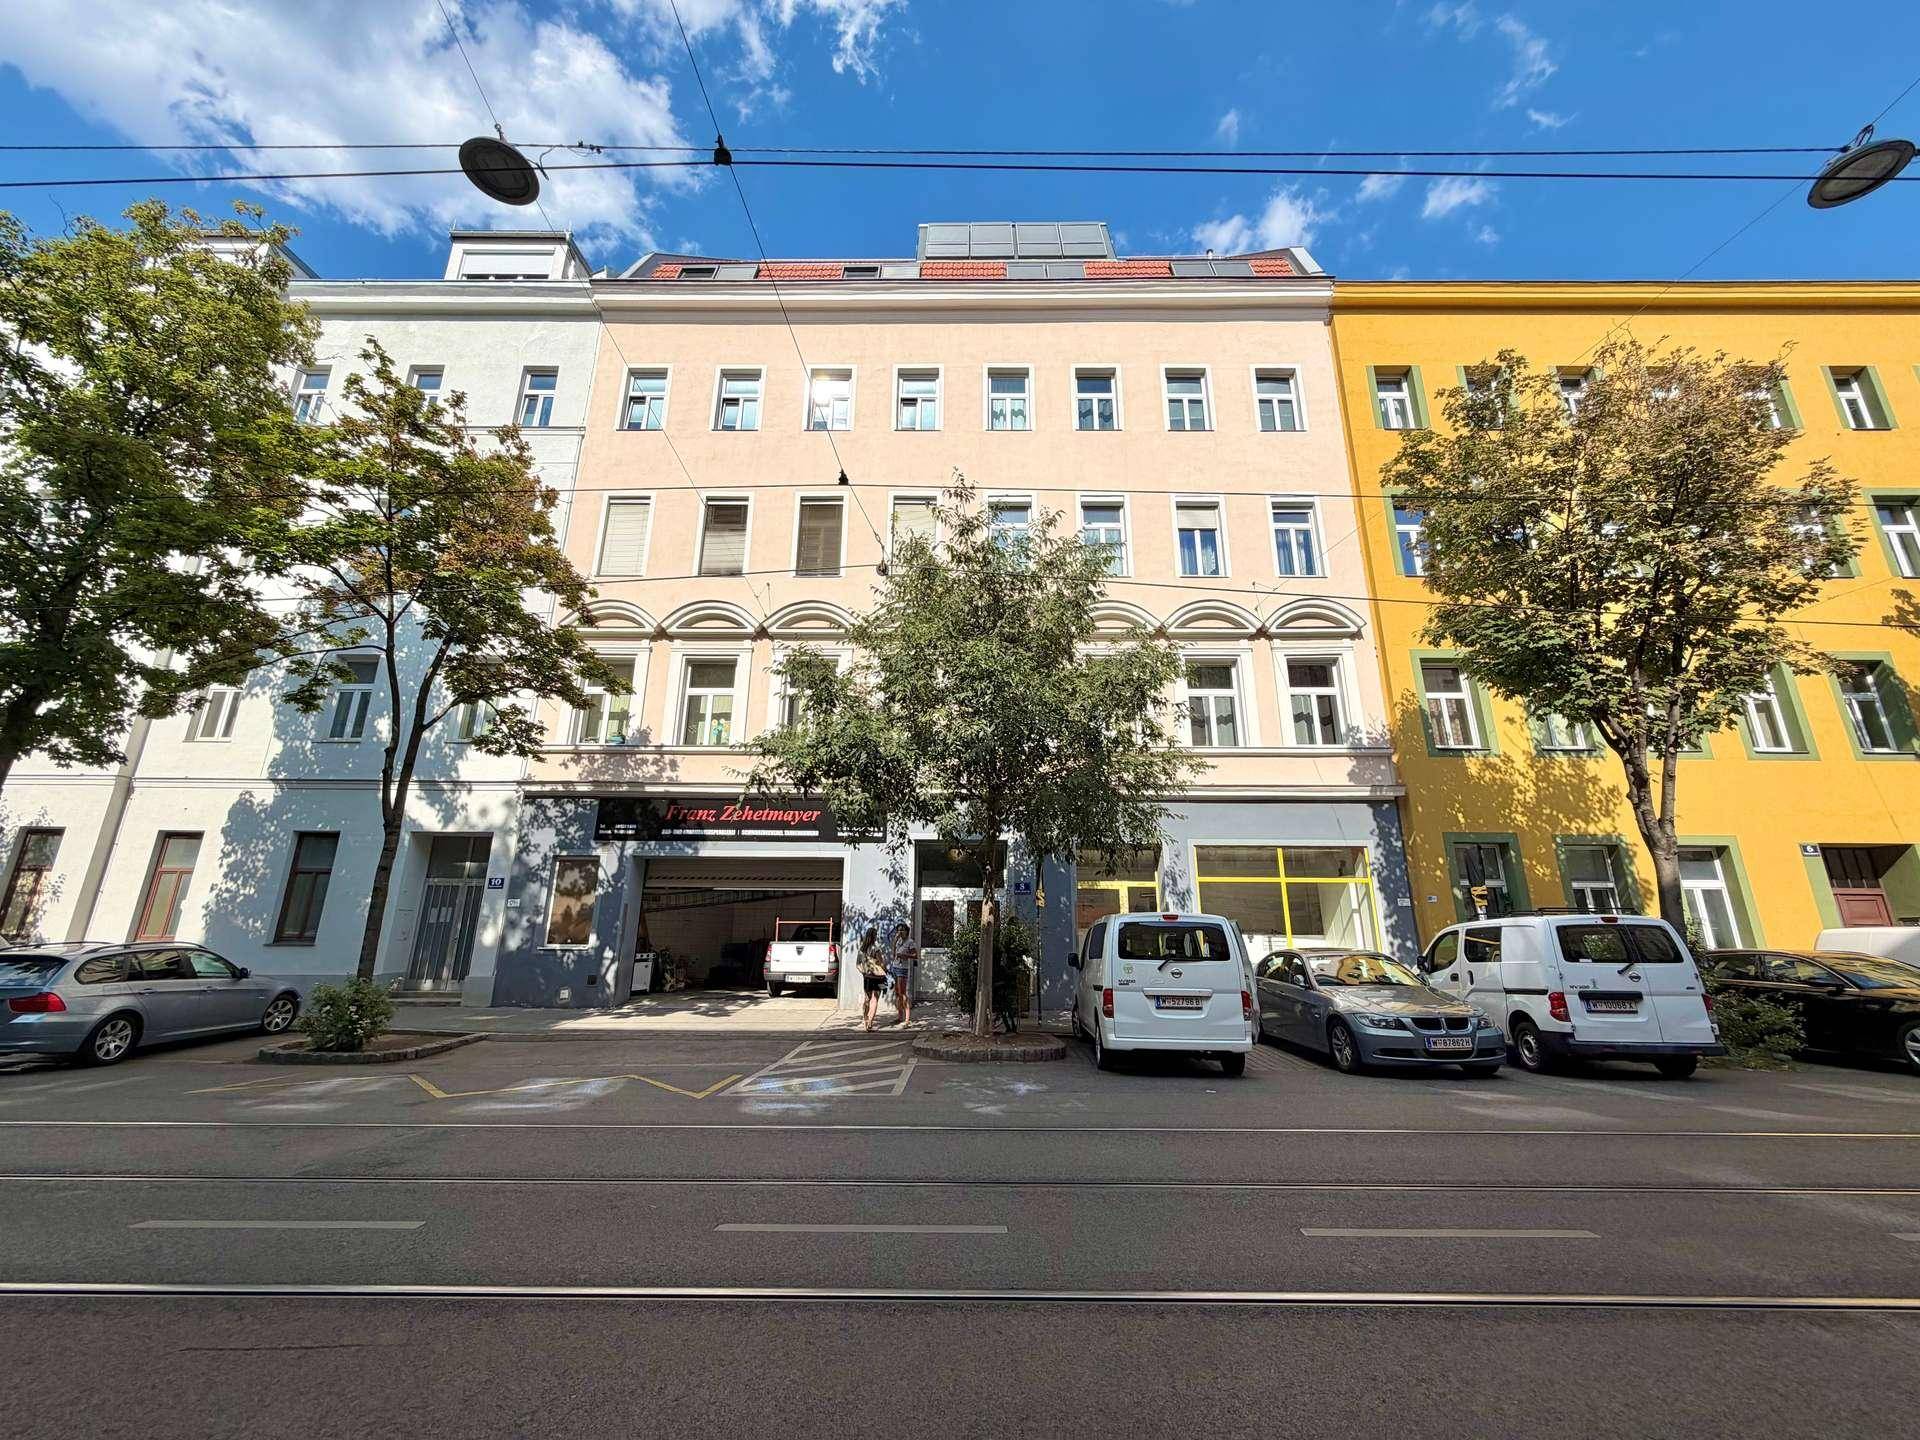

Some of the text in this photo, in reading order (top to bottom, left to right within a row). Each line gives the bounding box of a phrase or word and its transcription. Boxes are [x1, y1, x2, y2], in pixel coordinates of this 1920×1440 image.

[665, 805, 821, 825] Franz Zehetmayer
[1807, 845, 1814, 853] 6
